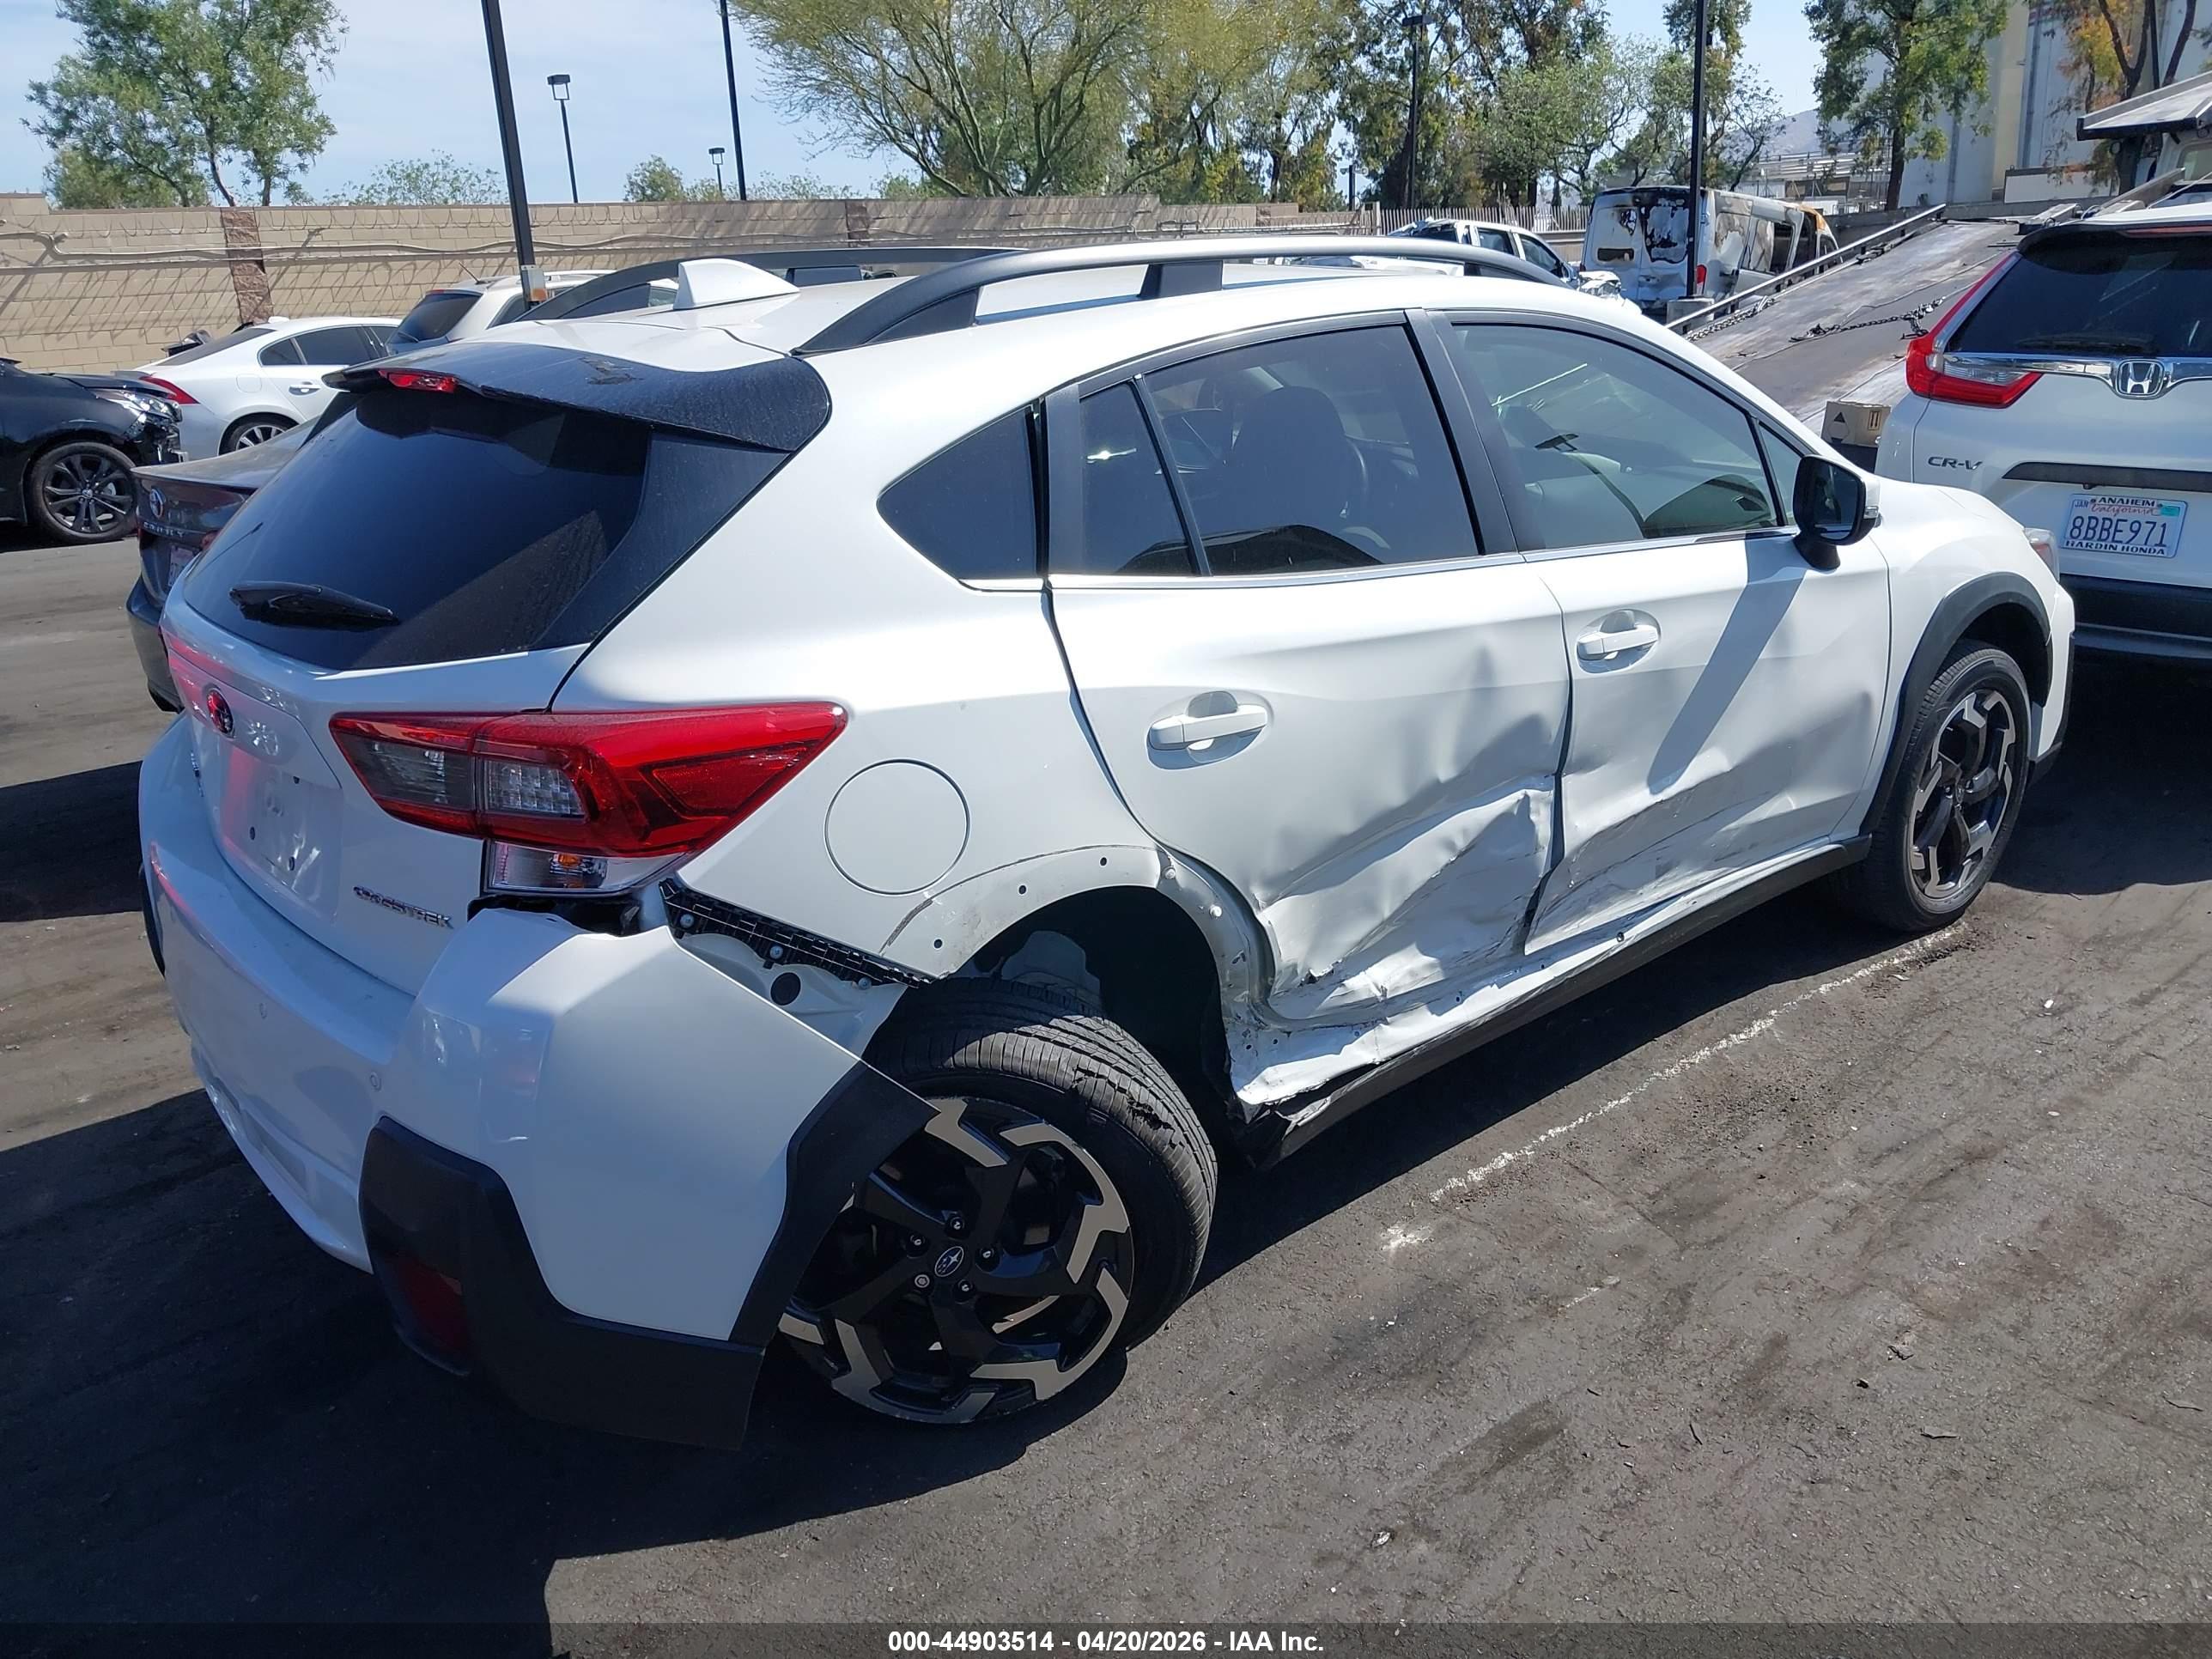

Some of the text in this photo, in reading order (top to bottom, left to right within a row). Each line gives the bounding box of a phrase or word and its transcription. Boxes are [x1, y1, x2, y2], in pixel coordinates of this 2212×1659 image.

[1928, 456, 1983, 470] CR-V
[2074, 500, 2089, 508] JAN
[2098, 496, 2155, 507] ANAHEIM
[2090, 503, 2155, 517] California
[2069, 515, 2167, 548] 8BBE971
[2065, 540, 2166, 556] HARDIN HONDA
[352, 885, 454, 929] CROSSTREK
